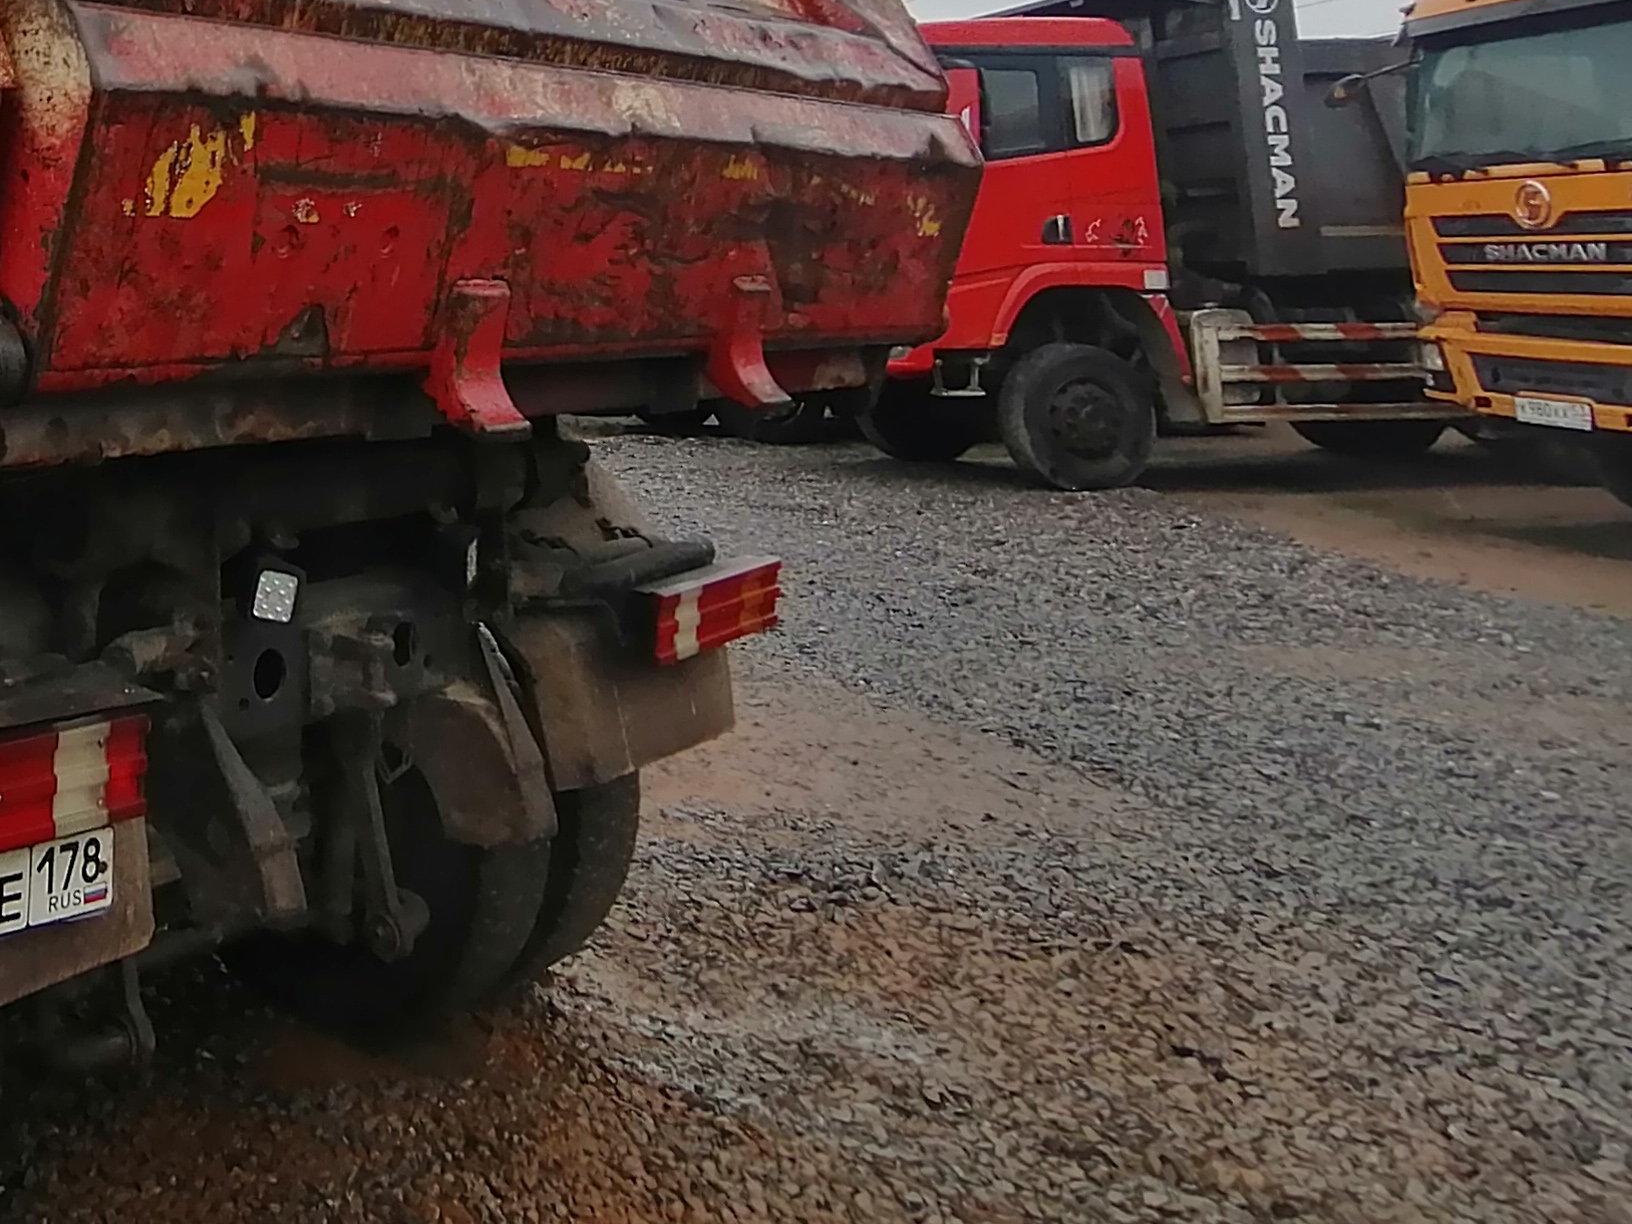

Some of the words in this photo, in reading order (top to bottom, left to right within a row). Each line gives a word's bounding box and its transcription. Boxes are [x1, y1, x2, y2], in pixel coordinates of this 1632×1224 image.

[1254, 19, 1300, 228] SHACMAN
[1483, 243, 1607, 261] SHACMAN
[36, 837, 102, 895] 178
[48, 890, 82, 913] RUS
